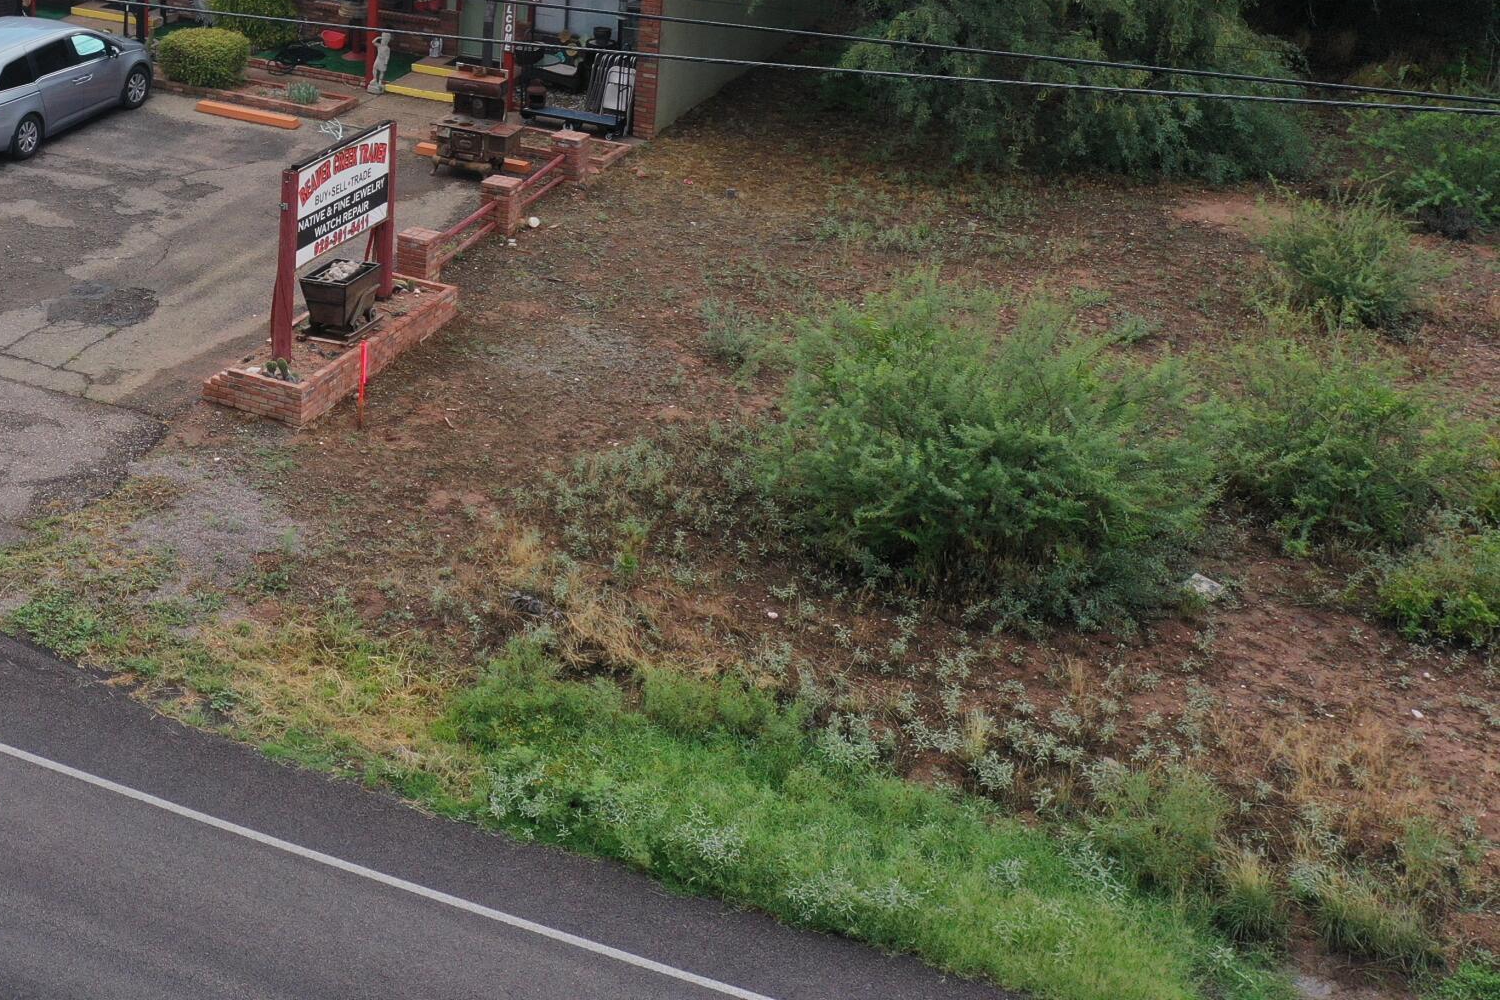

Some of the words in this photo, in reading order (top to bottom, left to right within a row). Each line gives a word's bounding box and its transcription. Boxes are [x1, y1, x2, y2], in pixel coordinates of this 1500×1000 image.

[299, 160, 331, 207] BEAVER
[333, 146, 359, 175] CREEK
[298, 209, 326, 232] NATIVE
[326, 206, 333, 217] &
[333, 196, 351, 214] FINE
[351, 178, 385, 204] JEWELRY
[314, 215, 341, 237] WATCH
[342, 201, 369, 222] REPAIR
